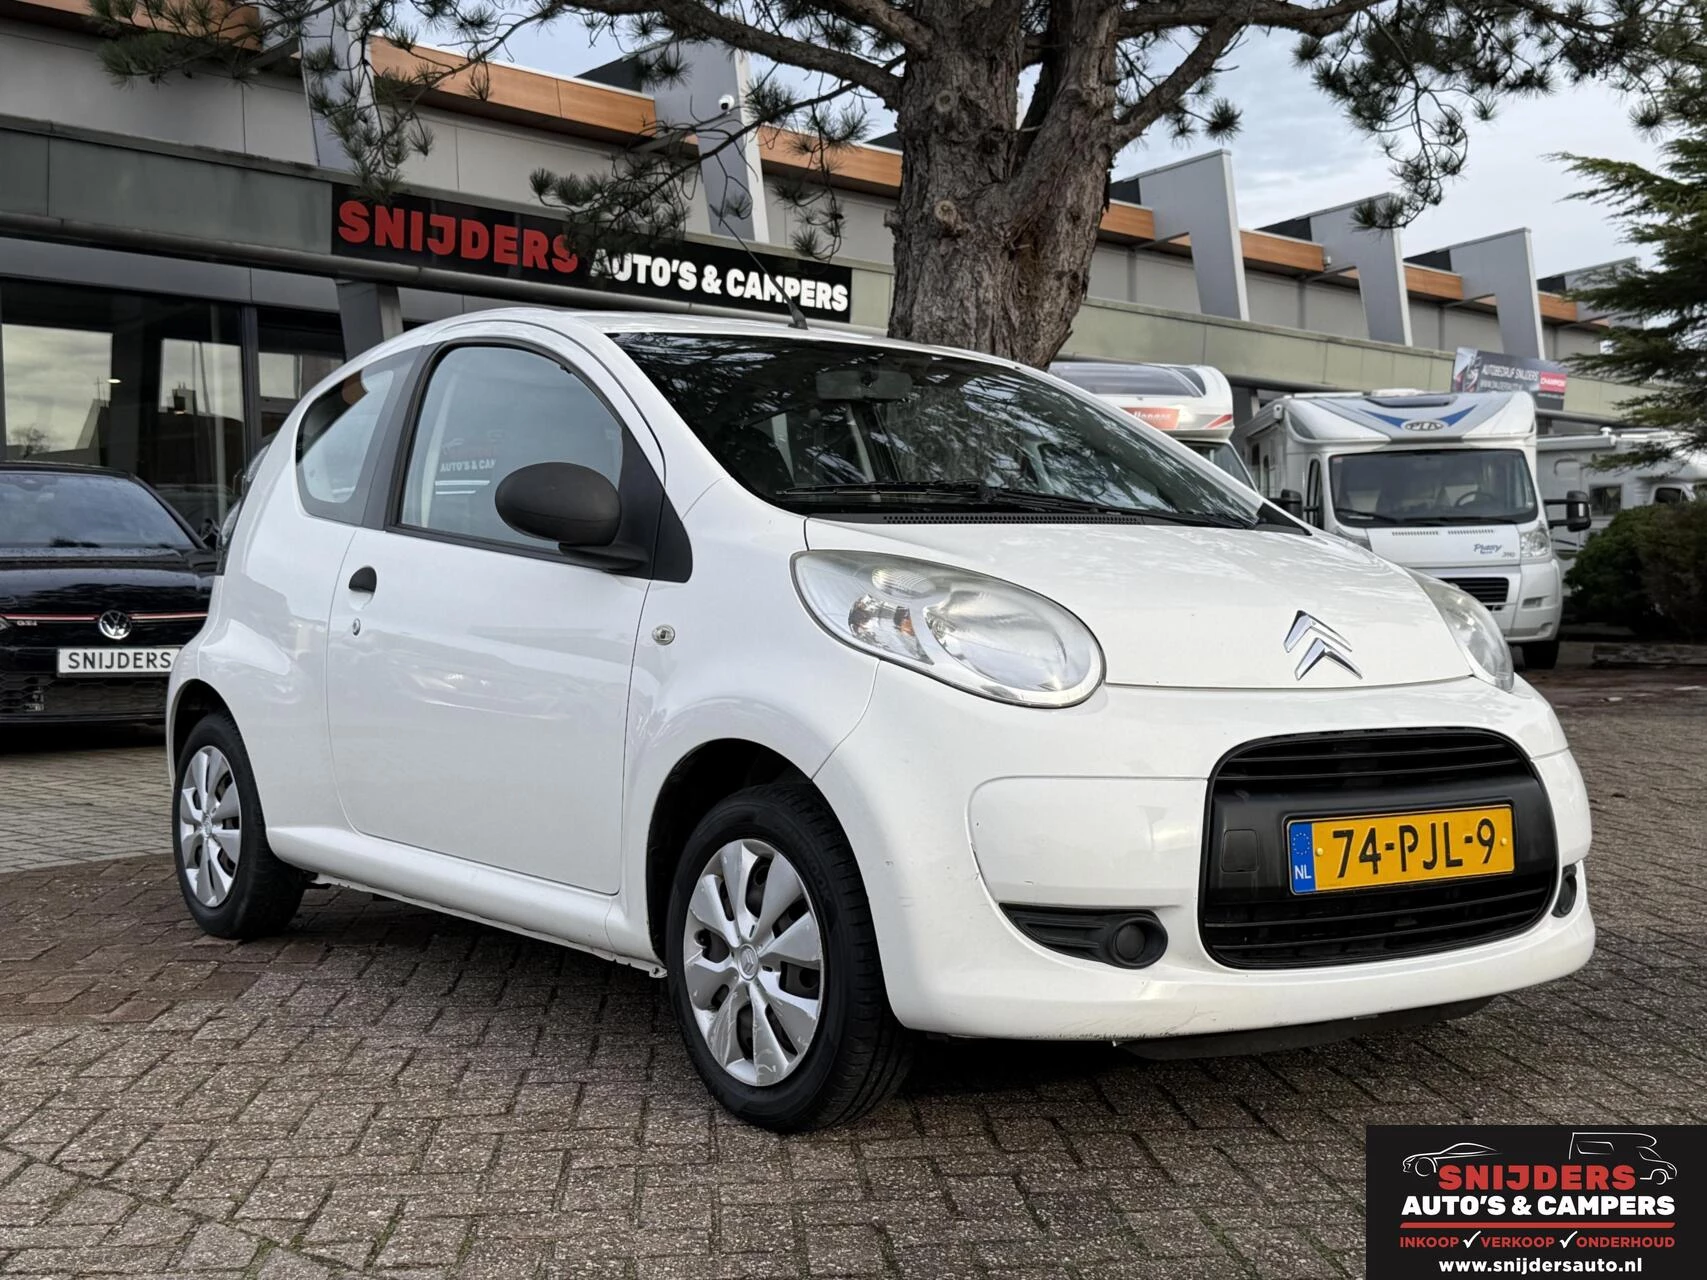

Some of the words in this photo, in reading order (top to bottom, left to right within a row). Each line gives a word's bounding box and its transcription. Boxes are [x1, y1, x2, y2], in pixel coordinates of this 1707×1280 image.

[338, 200, 578, 273] SNIJDERS
[590, 248, 698, 291] AUTO'S
[701, 264, 722, 295] &
[726, 268, 849, 312] CAMPERS
[68, 652, 171, 669] SNIJDERS
[1295, 865, 1312, 880] NL
[1332, 818, 1495, 879] 74-PJL-9
